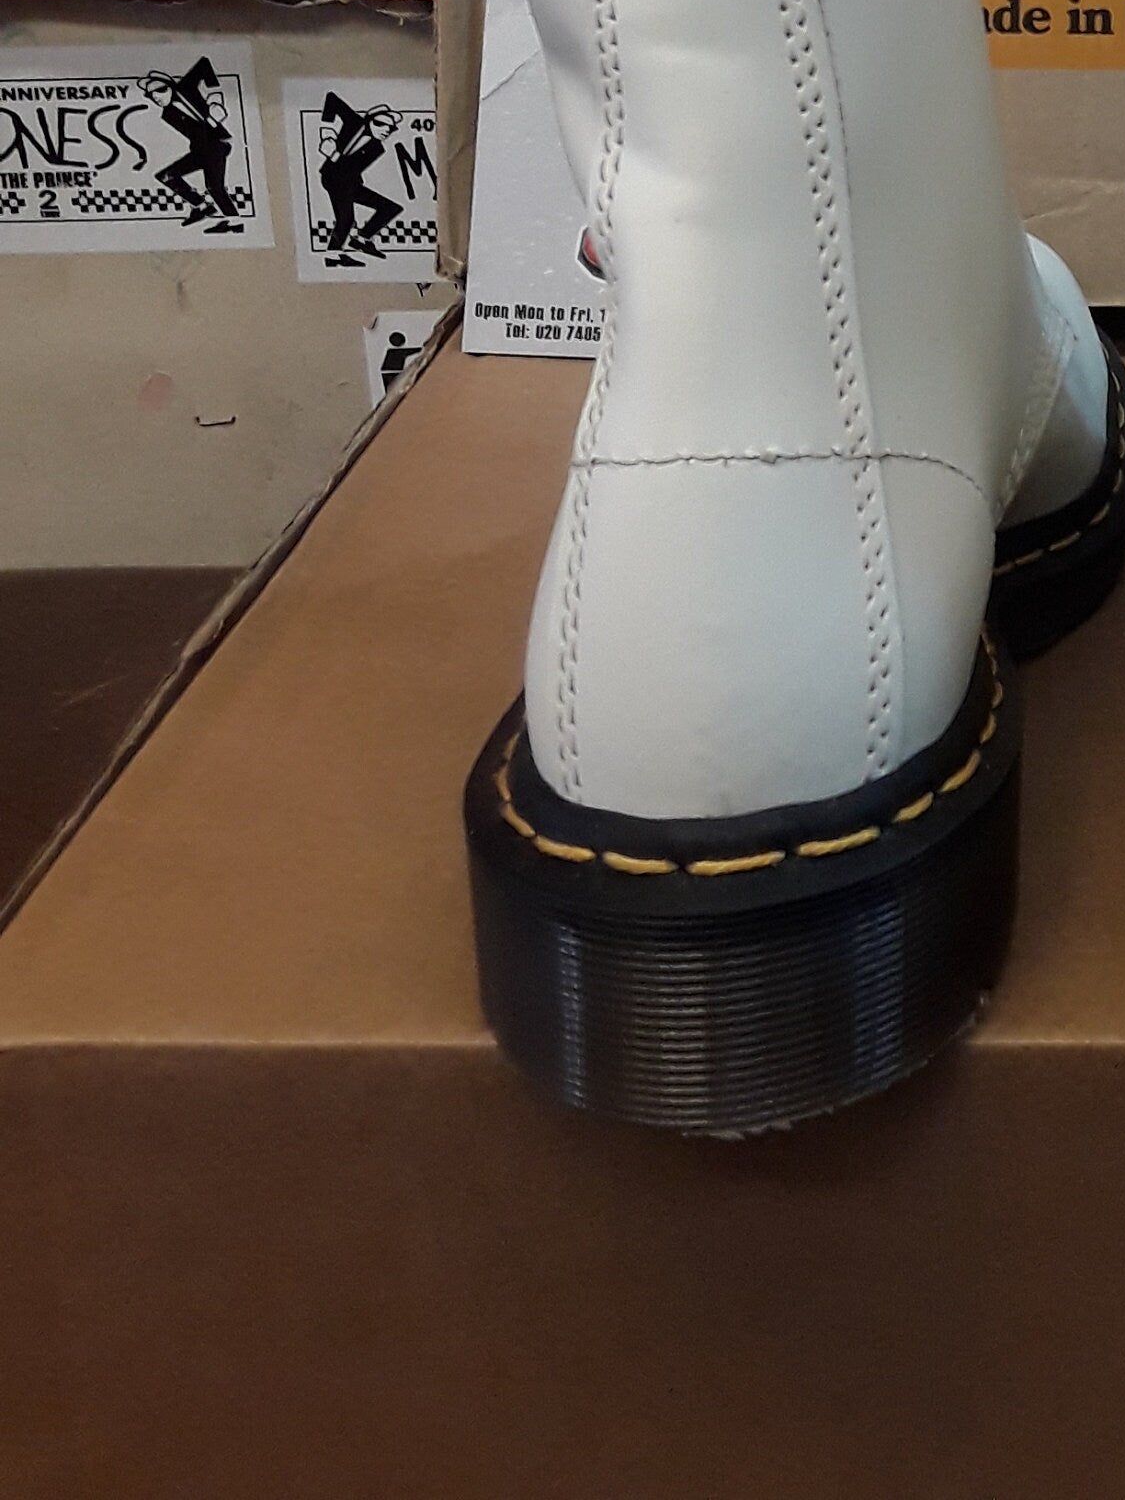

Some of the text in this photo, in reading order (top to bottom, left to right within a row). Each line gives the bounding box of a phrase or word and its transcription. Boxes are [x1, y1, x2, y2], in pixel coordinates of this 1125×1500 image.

[474, 302, 510, 321] Open
[514, 304, 545, 321] Mon
[550, 306, 565, 321] to
[569, 306, 594, 323] Fri.
